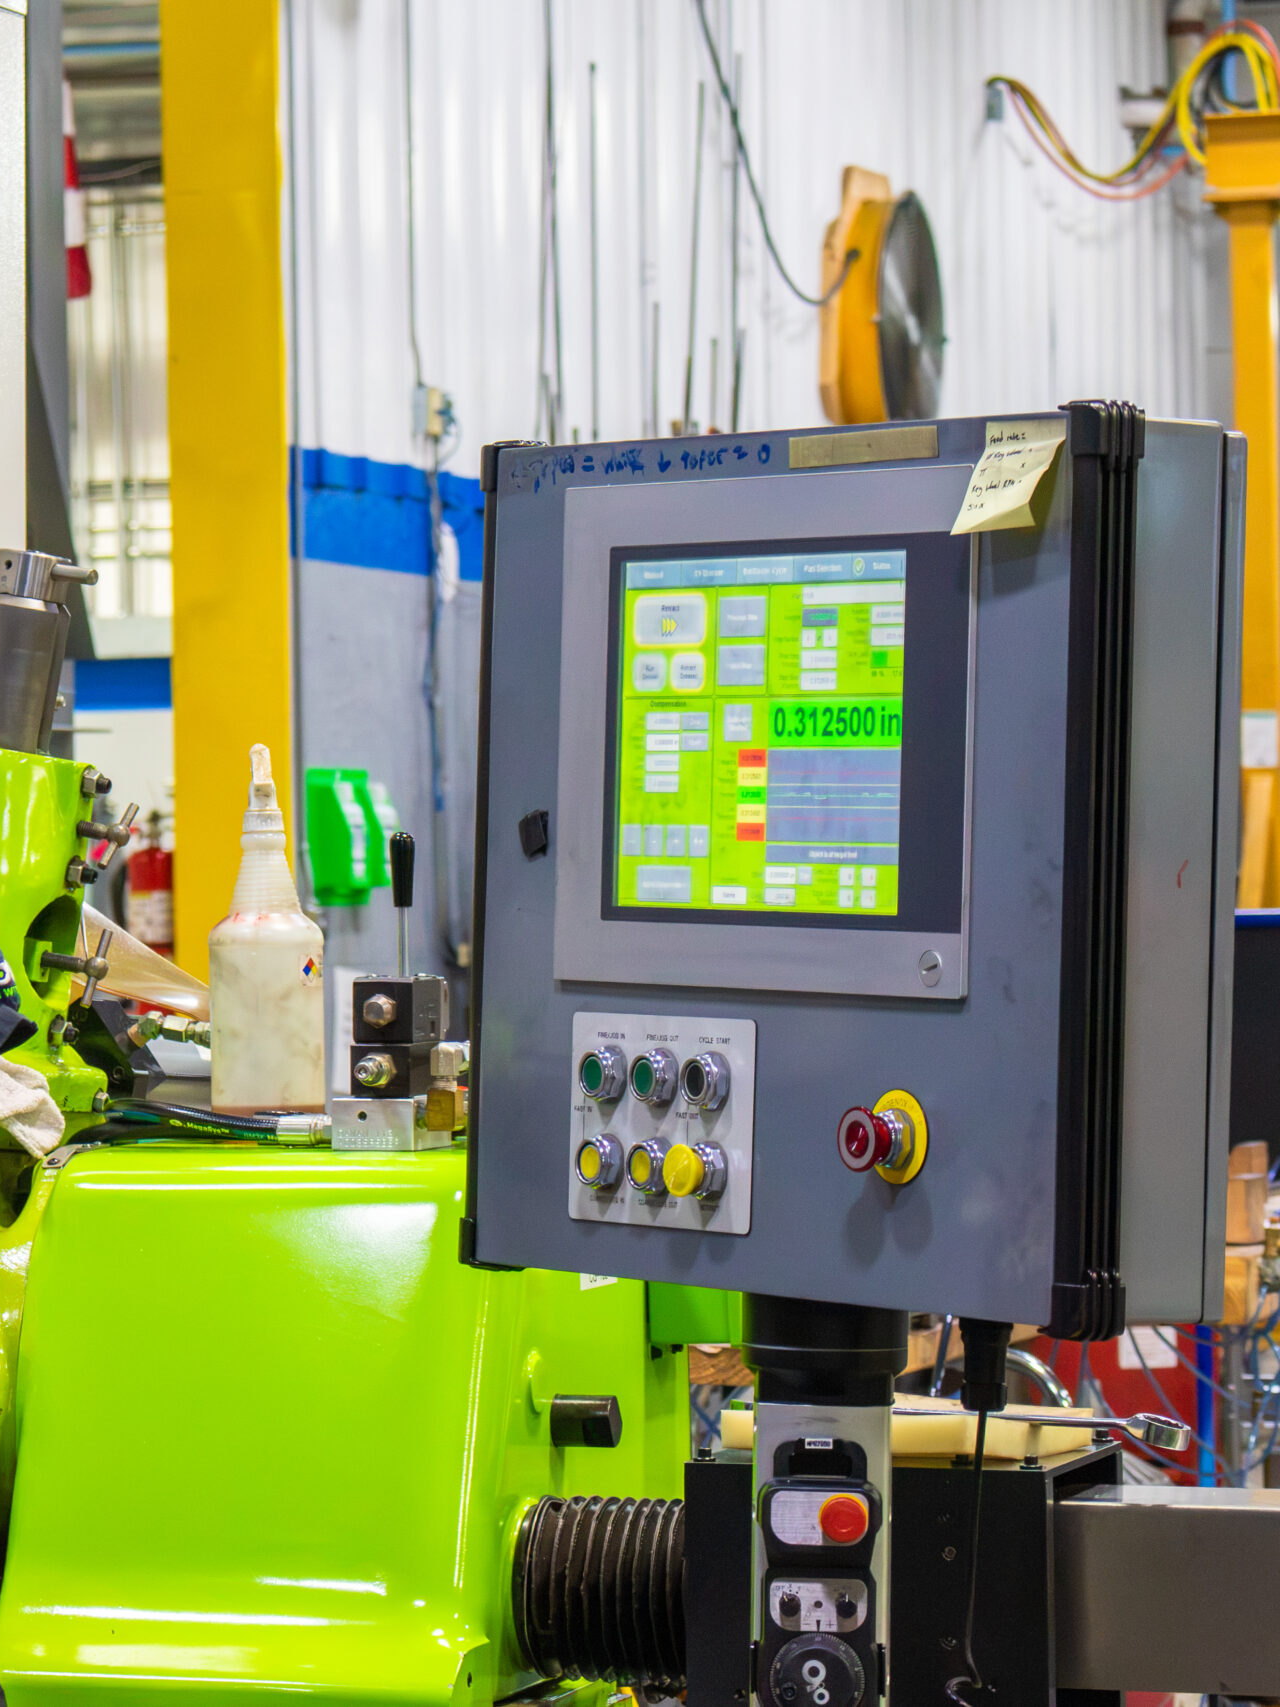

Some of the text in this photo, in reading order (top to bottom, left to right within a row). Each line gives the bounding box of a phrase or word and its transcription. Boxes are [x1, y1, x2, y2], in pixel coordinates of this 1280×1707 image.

[774, 706, 876, 738] 0.312500
[880, 706, 901, 737] in
[698, 1036, 731, 1045] CYCLE START
